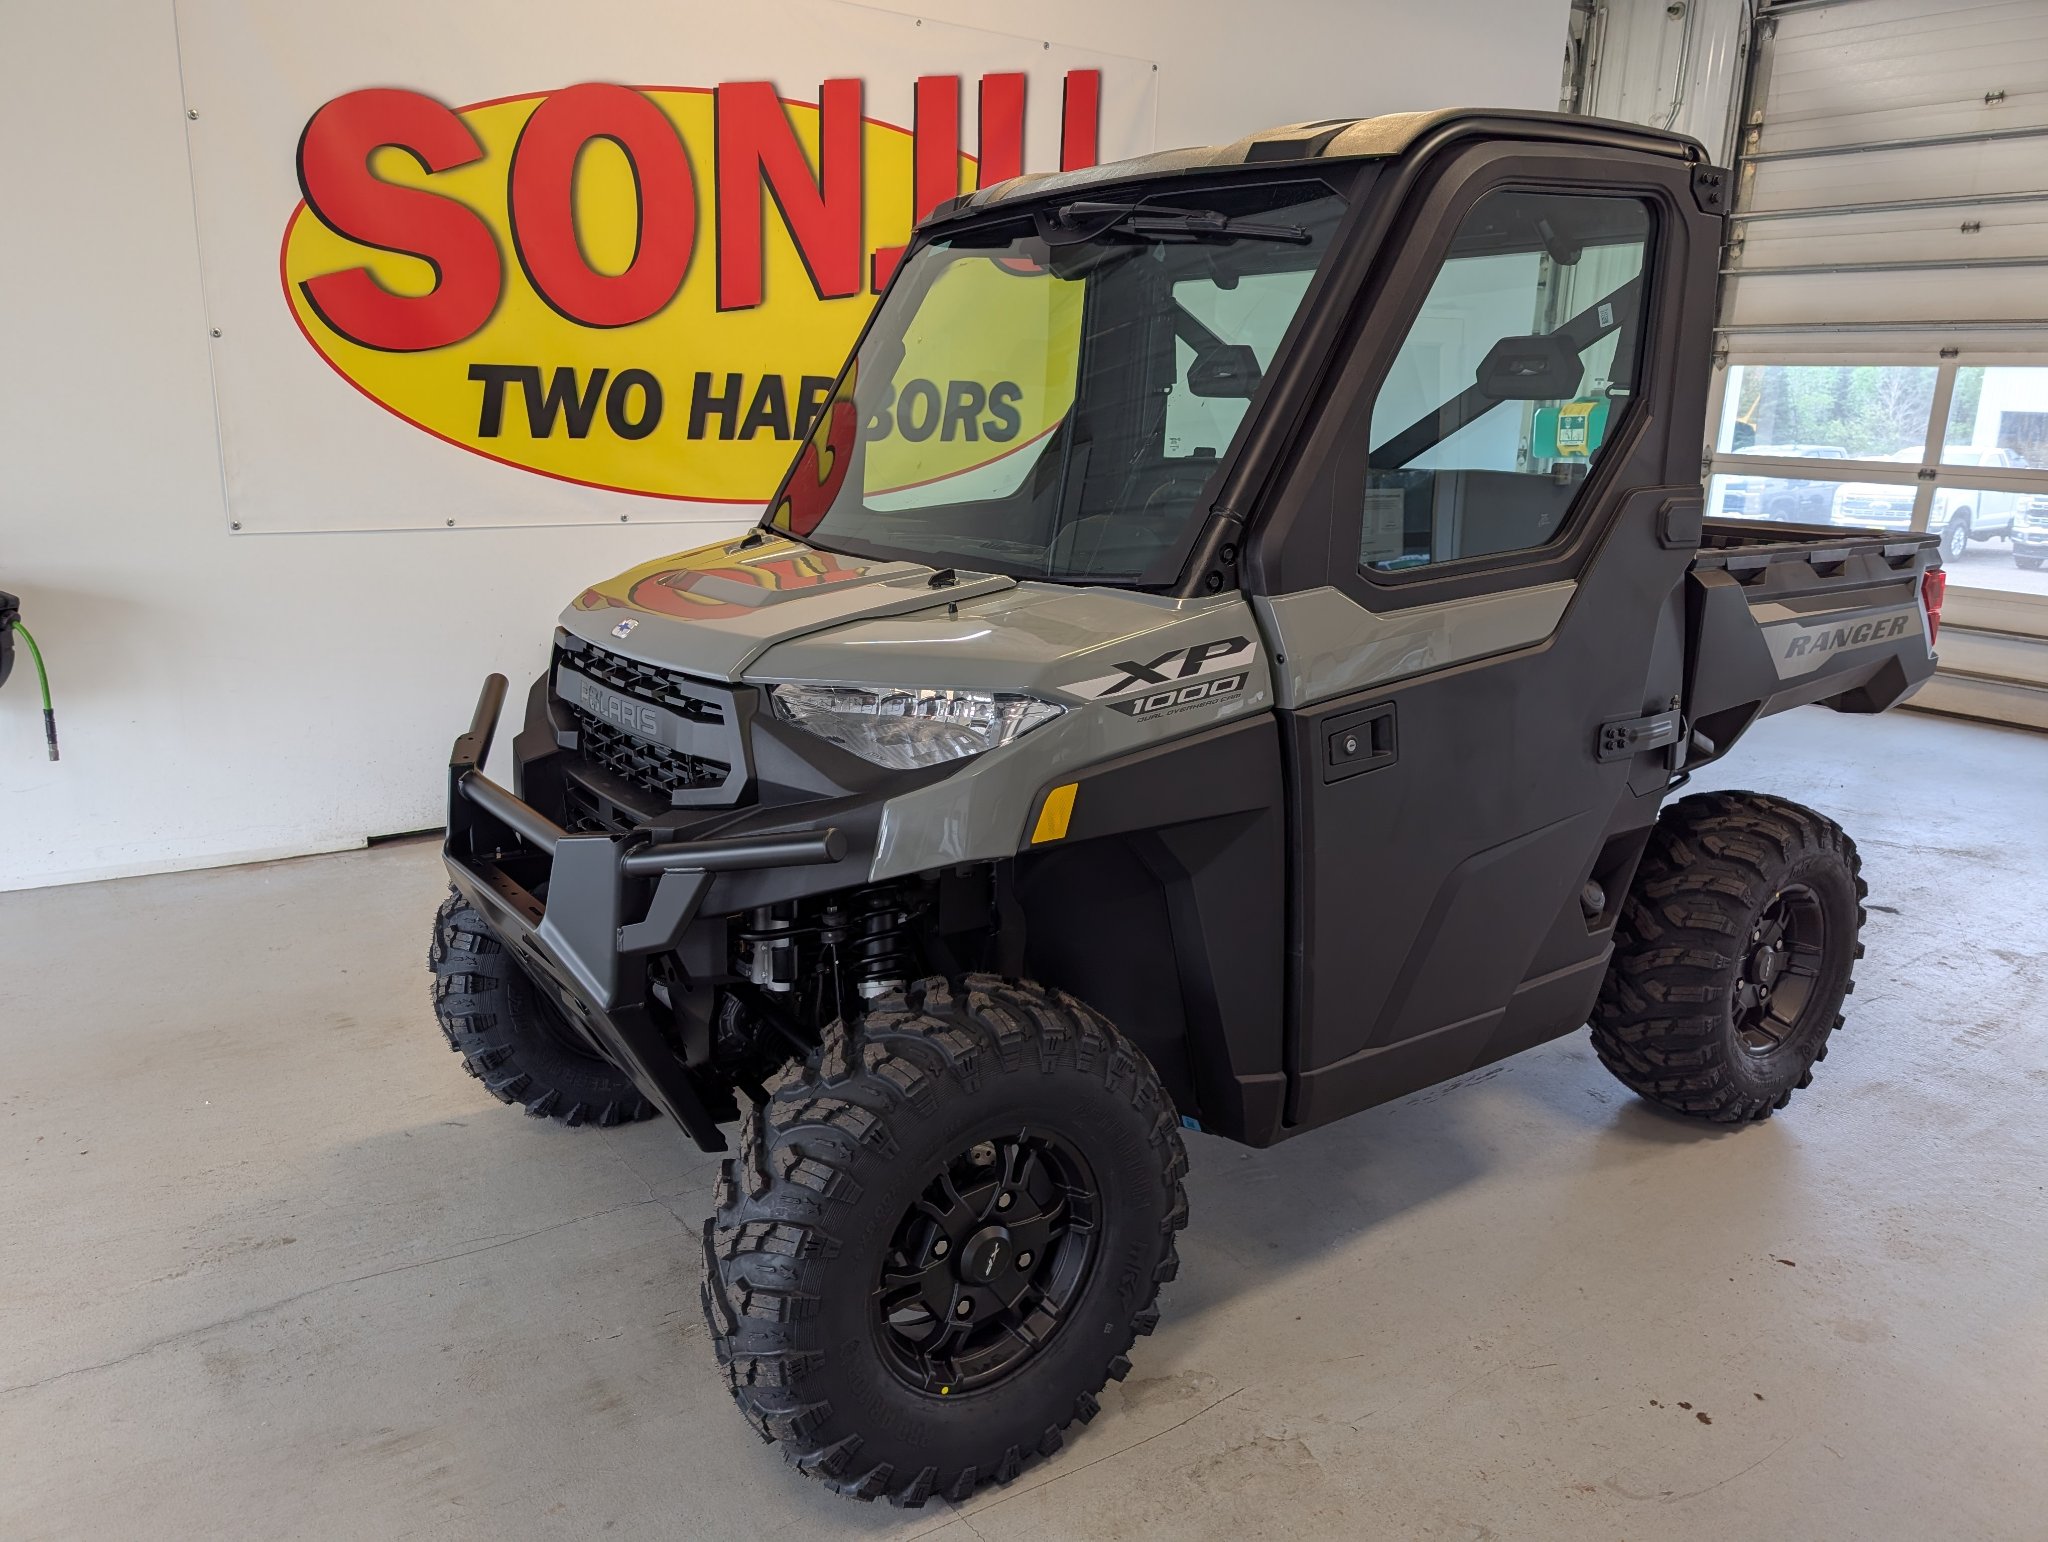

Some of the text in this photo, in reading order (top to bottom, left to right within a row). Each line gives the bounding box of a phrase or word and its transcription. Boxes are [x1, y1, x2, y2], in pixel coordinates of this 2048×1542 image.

[467, 363, 664, 441] TWO
[1785, 614, 1909, 659] RANGER
[1096, 635, 1252, 698] XP
[580, 679, 657, 735] POLARIS
[1132, 675, 1241, 715] 1000
